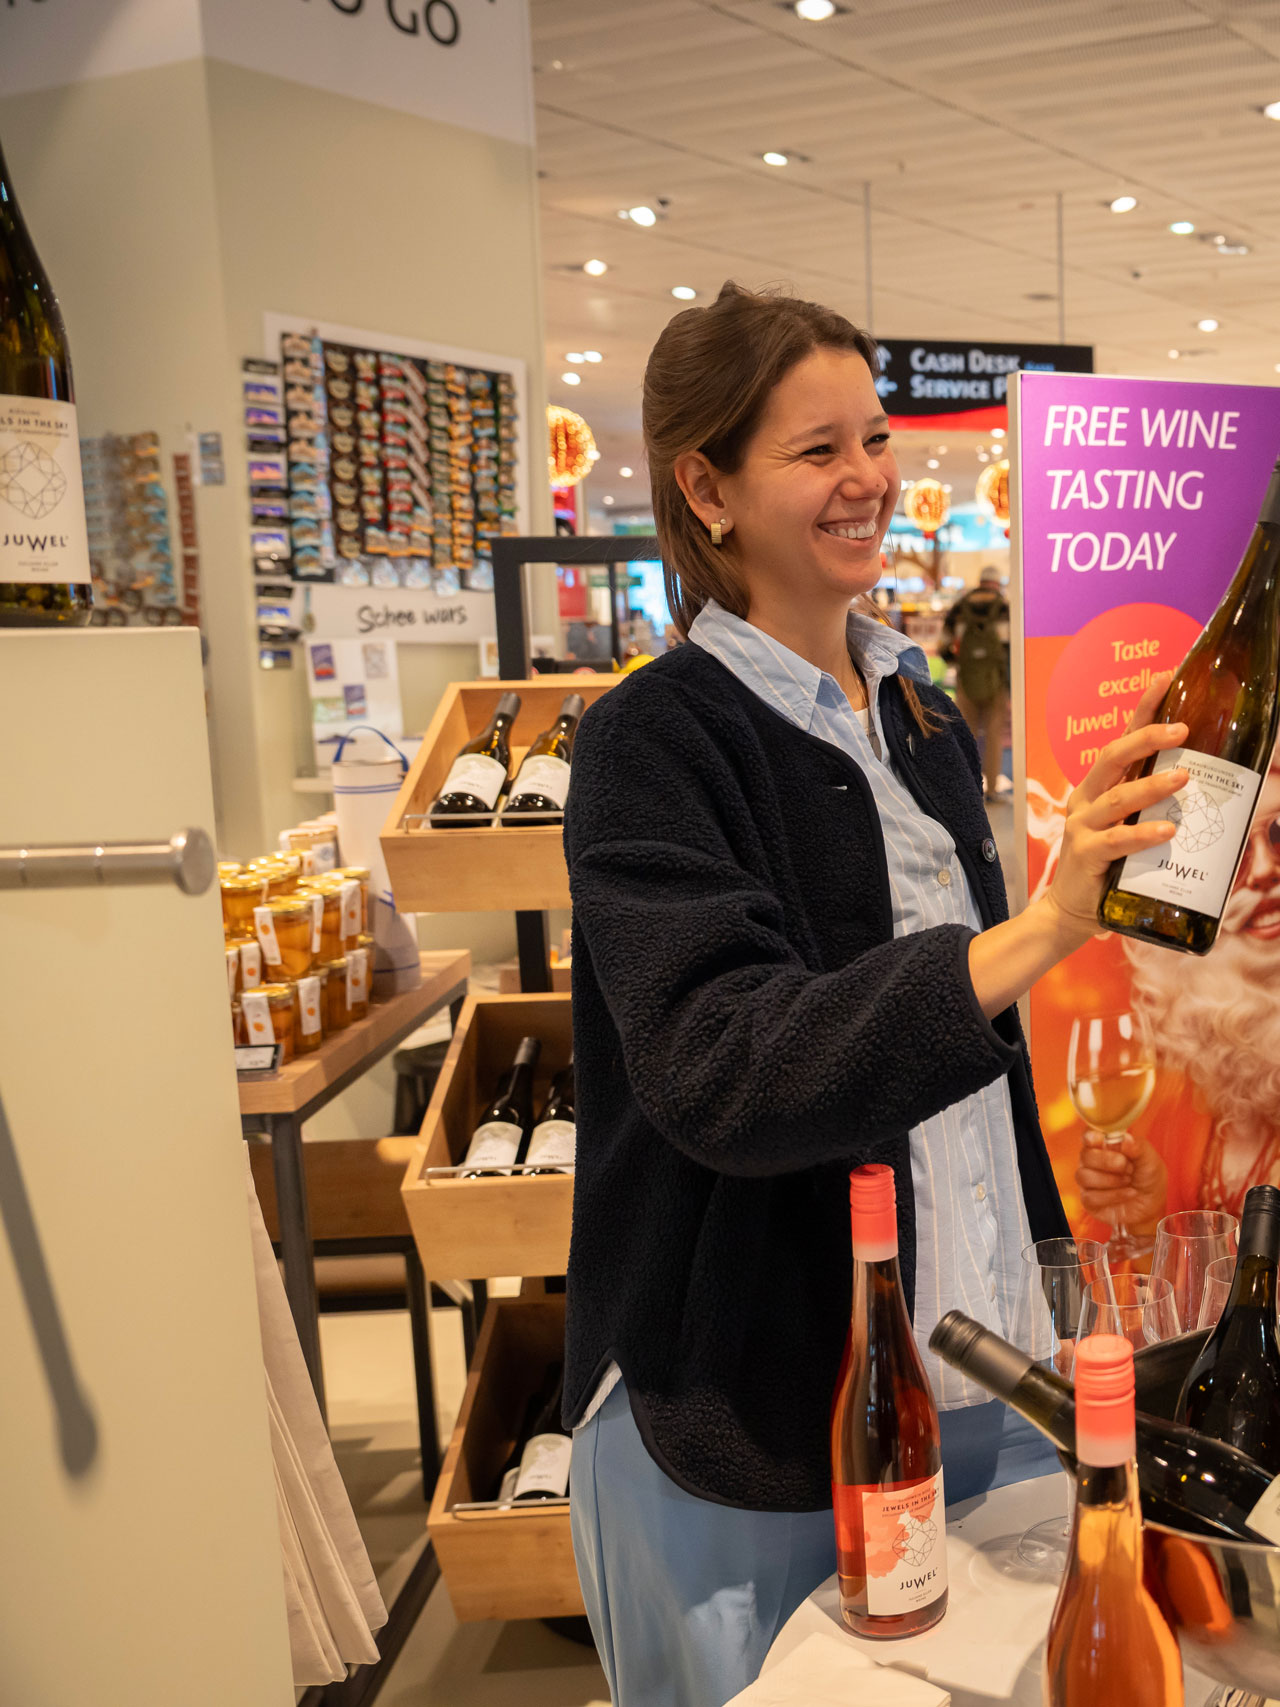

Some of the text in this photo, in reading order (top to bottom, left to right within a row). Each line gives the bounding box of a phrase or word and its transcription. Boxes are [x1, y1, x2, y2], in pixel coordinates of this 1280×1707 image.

[1044, 404, 1240, 450] FREE WINE
[1046, 469, 1204, 510] TASTING
[3, 534, 67, 552] JUWEL
[1047, 531, 1178, 573] TODAY
[1111, 638, 1161, 663] Taste
[1065, 705, 1119, 742] Juwel
[1215, 775, 1230, 786] THE
[1157, 859, 1205, 881] JUWEL
[881, 1503, 910, 1513] JEWELS
[900, 1569, 937, 1590] JUWEL
